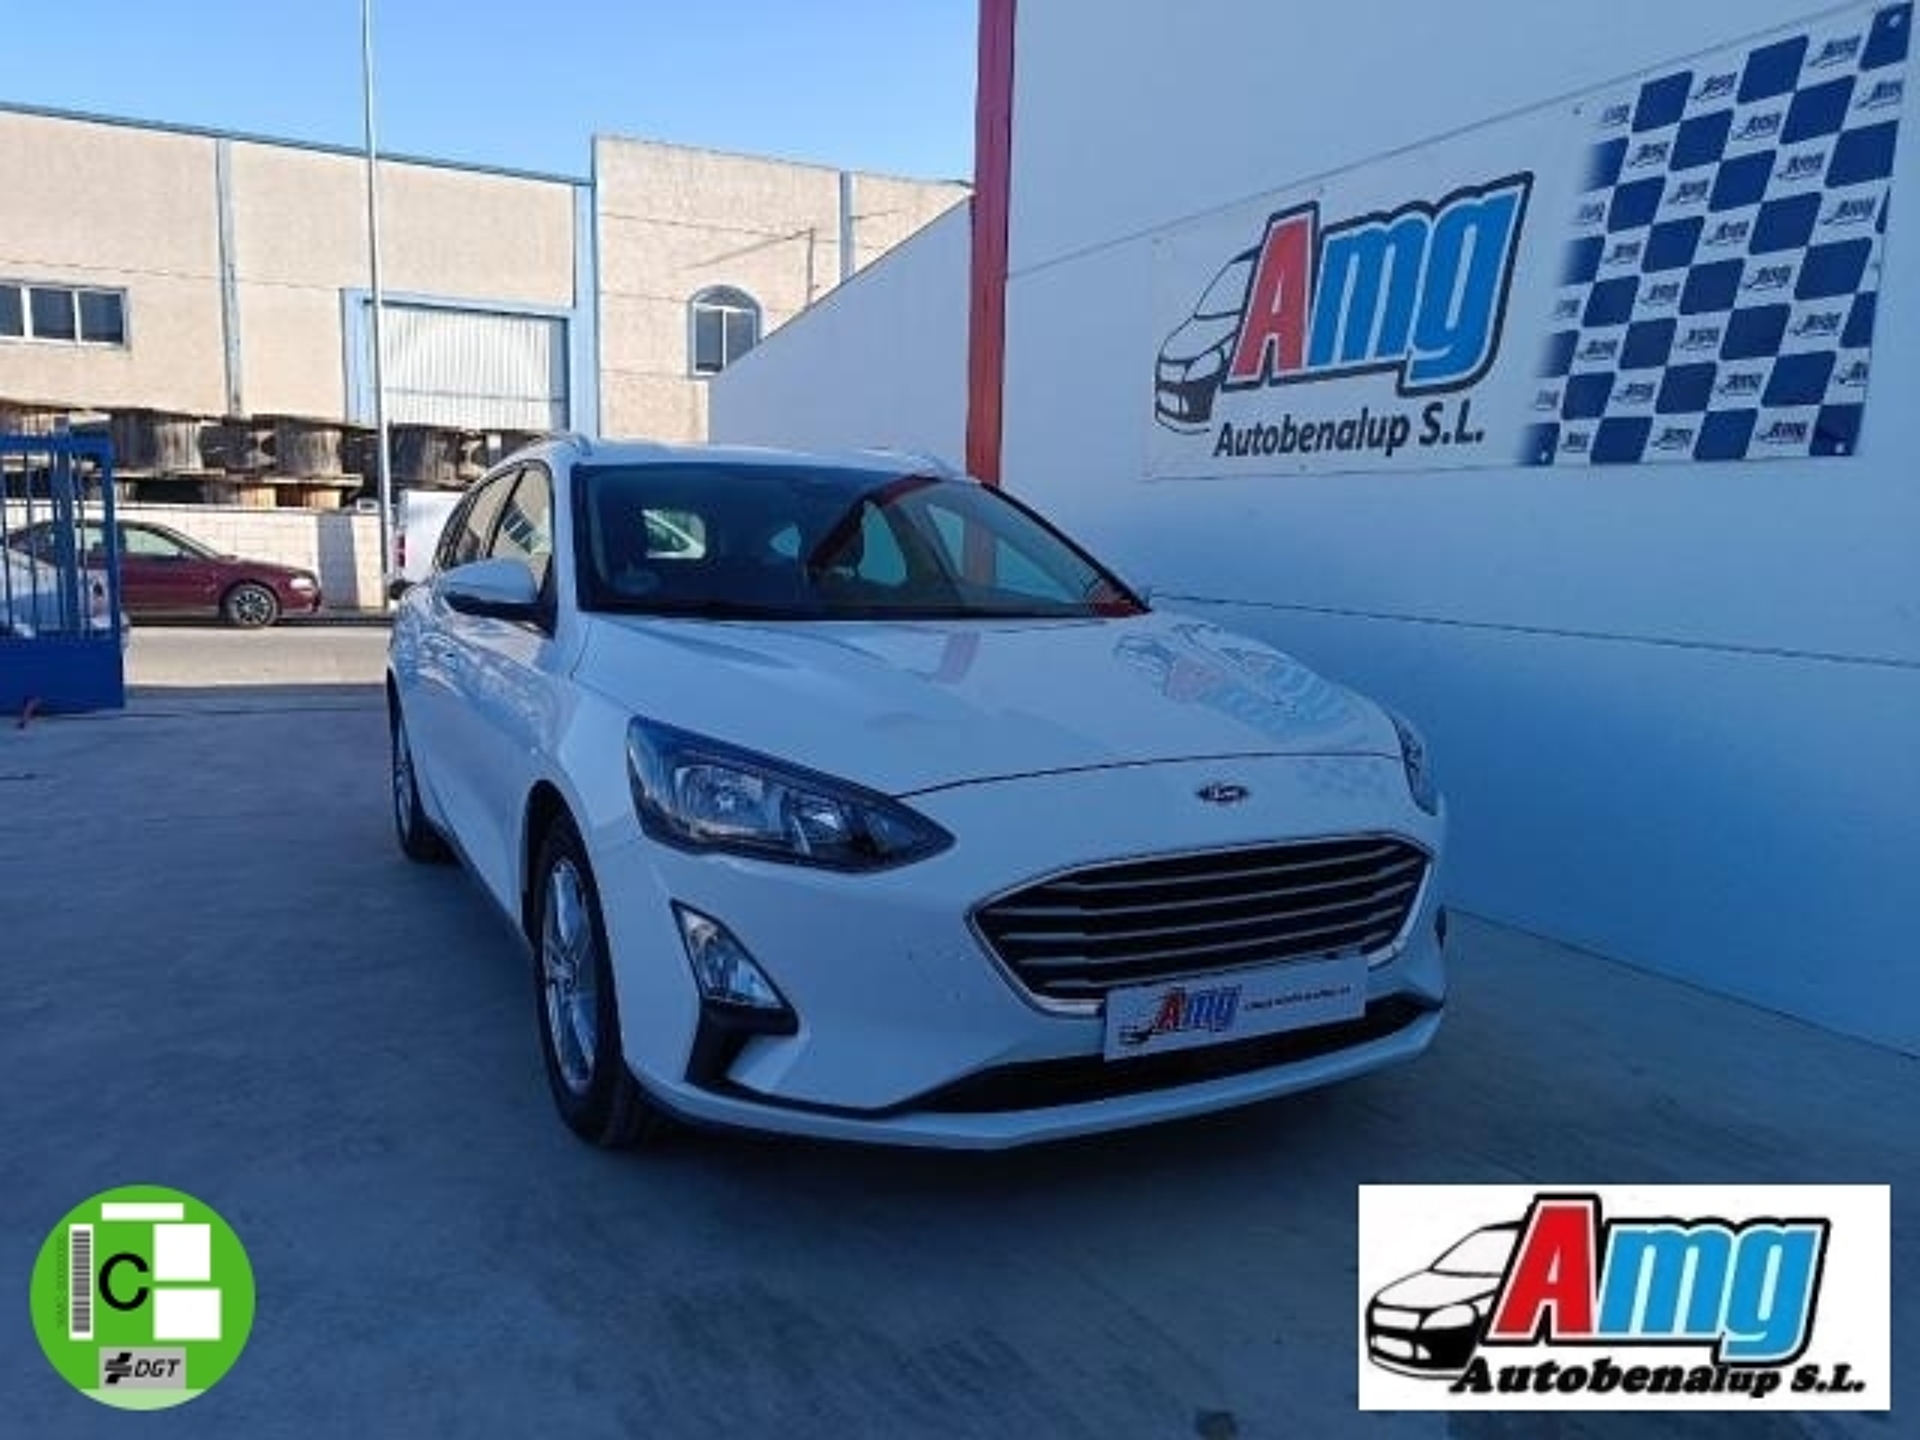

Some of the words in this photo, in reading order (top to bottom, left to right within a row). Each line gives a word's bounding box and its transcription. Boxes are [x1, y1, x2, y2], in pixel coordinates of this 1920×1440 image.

[1223, 171, 1533, 396] Amg
[1212, 406, 1410, 456] Autobenalup
[1419, 399, 1485, 446] S.L.
